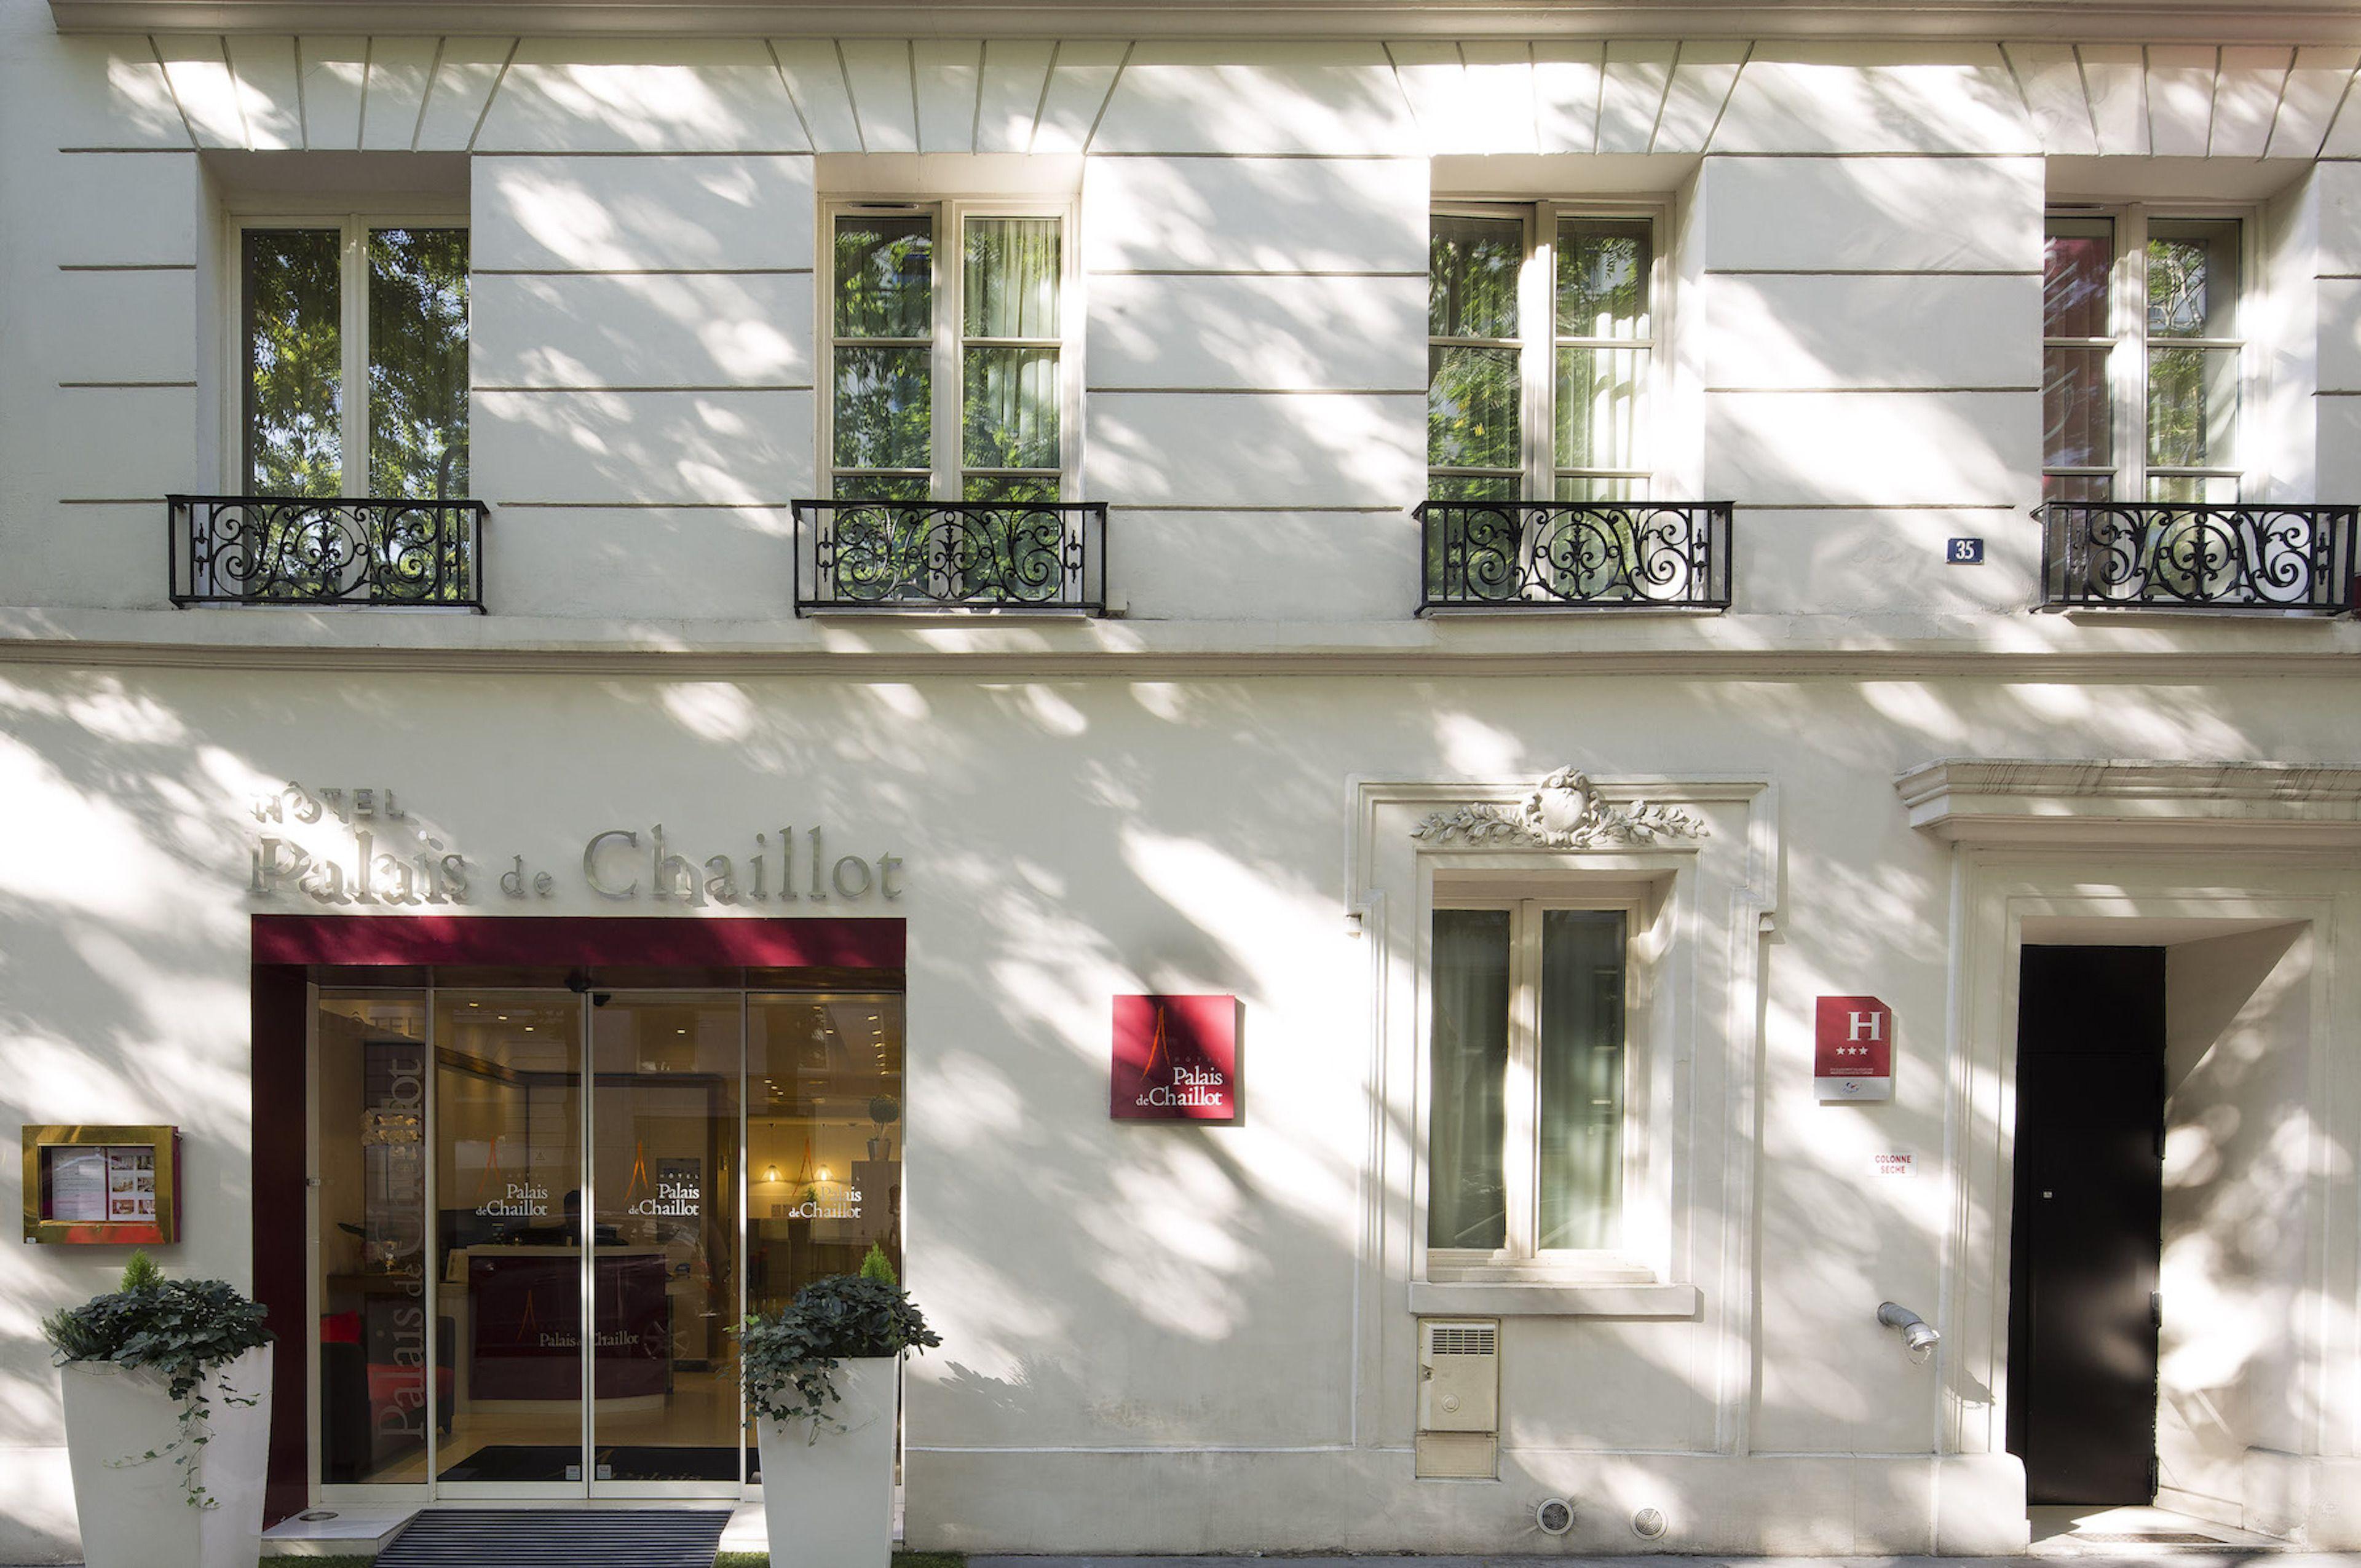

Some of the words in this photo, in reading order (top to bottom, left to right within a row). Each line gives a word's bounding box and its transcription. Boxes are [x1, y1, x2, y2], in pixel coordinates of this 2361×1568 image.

[1956, 540, 1975, 559] 35
[247, 824, 467, 894] Palais
[499, 854, 554, 896] de
[583, 823, 903, 899] Chaillot
[1847, 1012, 1883, 1041] H
[1173, 1065, 1223, 1085] Palais
[506, 1181, 548, 1199] Palais
[658, 1182, 700, 1199] Palais
[821, 1185, 862, 1202] Palais
[539, 1331, 575, 1347] Palais
[595, 1330, 639, 1347] haillot
[371, 1307, 424, 1440] Palais
